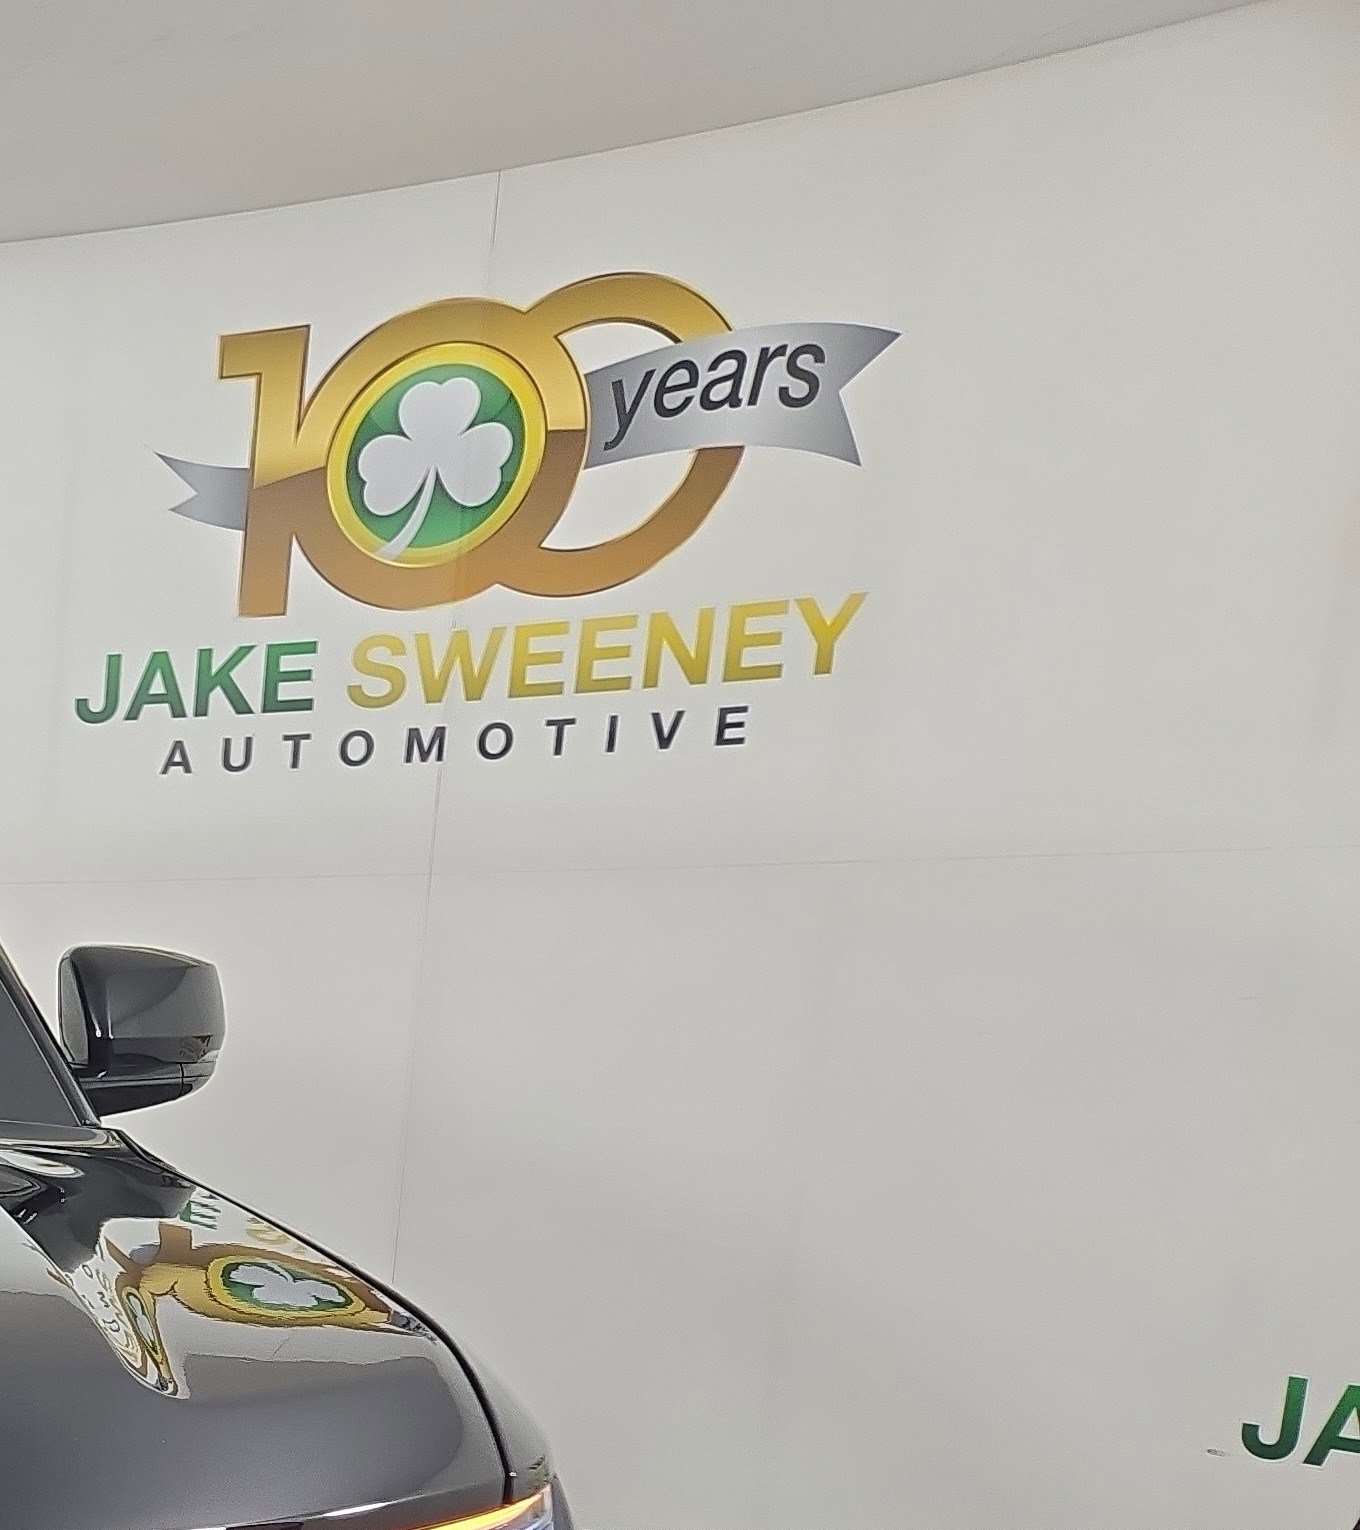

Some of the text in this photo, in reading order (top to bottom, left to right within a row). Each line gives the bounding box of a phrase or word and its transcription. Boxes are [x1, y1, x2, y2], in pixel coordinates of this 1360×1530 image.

[602, 337, 825, 452] years
[75, 591, 869, 725] JAKE SWEENEY
[160, 704, 750, 776] AUTOMOTIVE
